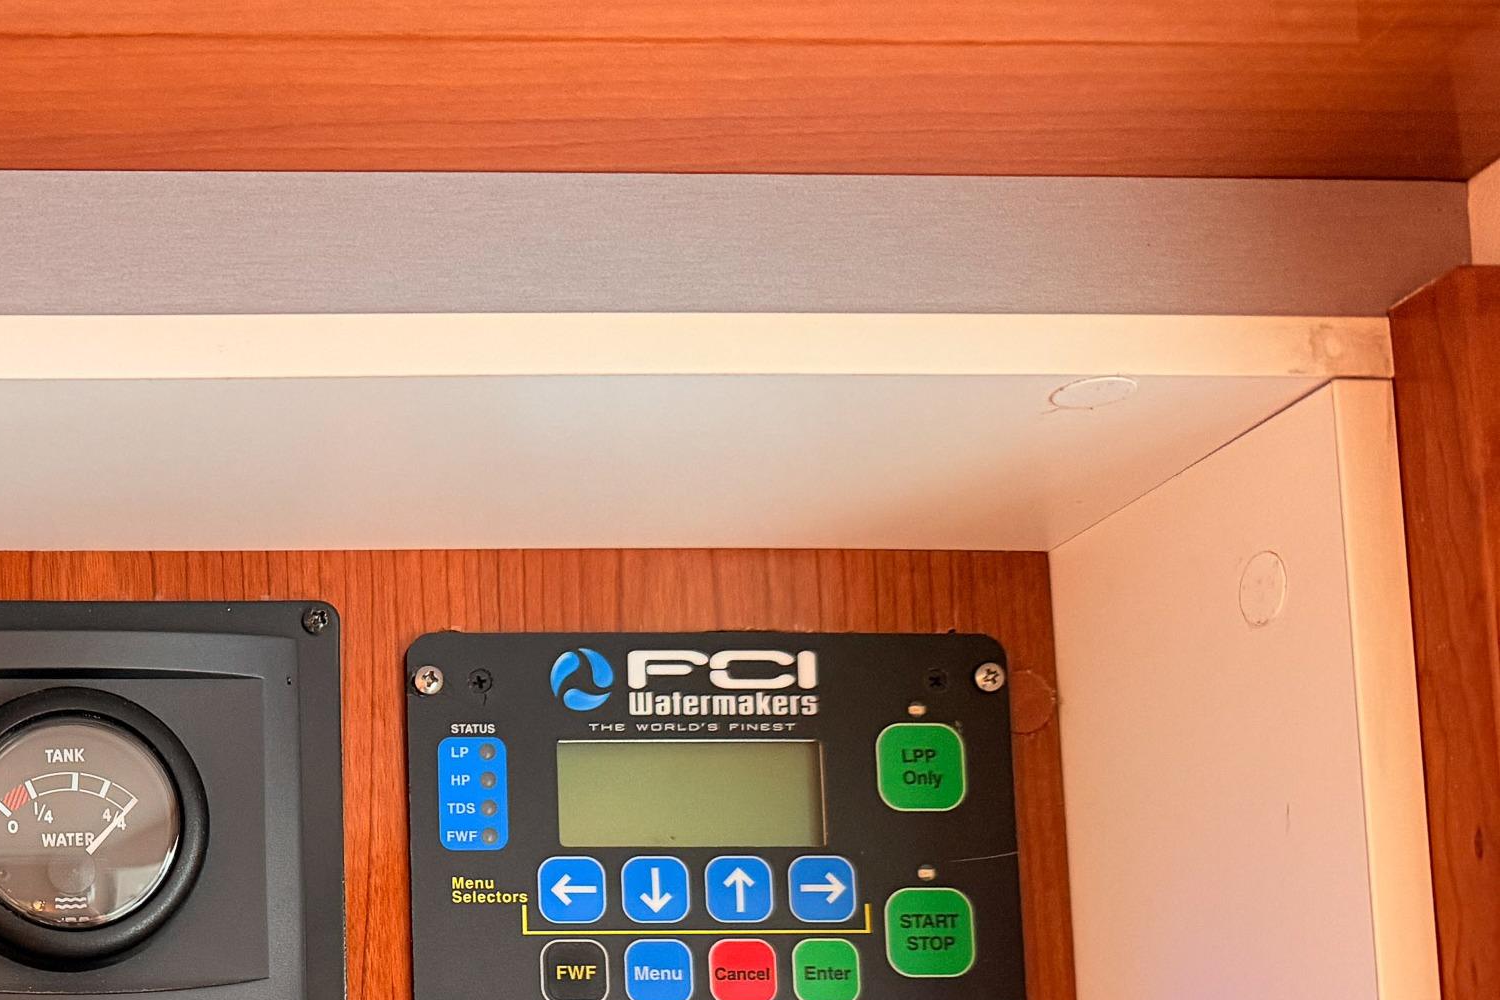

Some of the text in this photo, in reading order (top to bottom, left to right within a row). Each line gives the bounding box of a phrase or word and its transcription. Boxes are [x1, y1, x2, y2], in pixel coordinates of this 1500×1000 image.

[627, 650, 817, 689] FCI
[629, 692, 818, 716] Watermakers
[450, 723, 496, 734] STATUS
[588, 723, 797, 732] THE WORLD'S FINEST
[45, 748, 85, 763] TANK
[450, 747, 469, 758] LP
[901, 749, 936, 762] LPP
[450, 775, 471, 786] HP
[902, 771, 942, 788] Only
[447, 803, 476, 814] TDS
[41, 832, 95, 847] WATER
[446, 831, 478, 842] FWF
[451, 877, 495, 889] Menu
[451, 890, 528, 903] Selectors
[900, 914, 959, 929] START
[906, 936, 955, 951] STOP
[556, 965, 597, 980] FWF
[634, 966, 683, 981] Menu
[714, 967, 770, 981] Cancel
[804, 966, 851, 981] Enter
